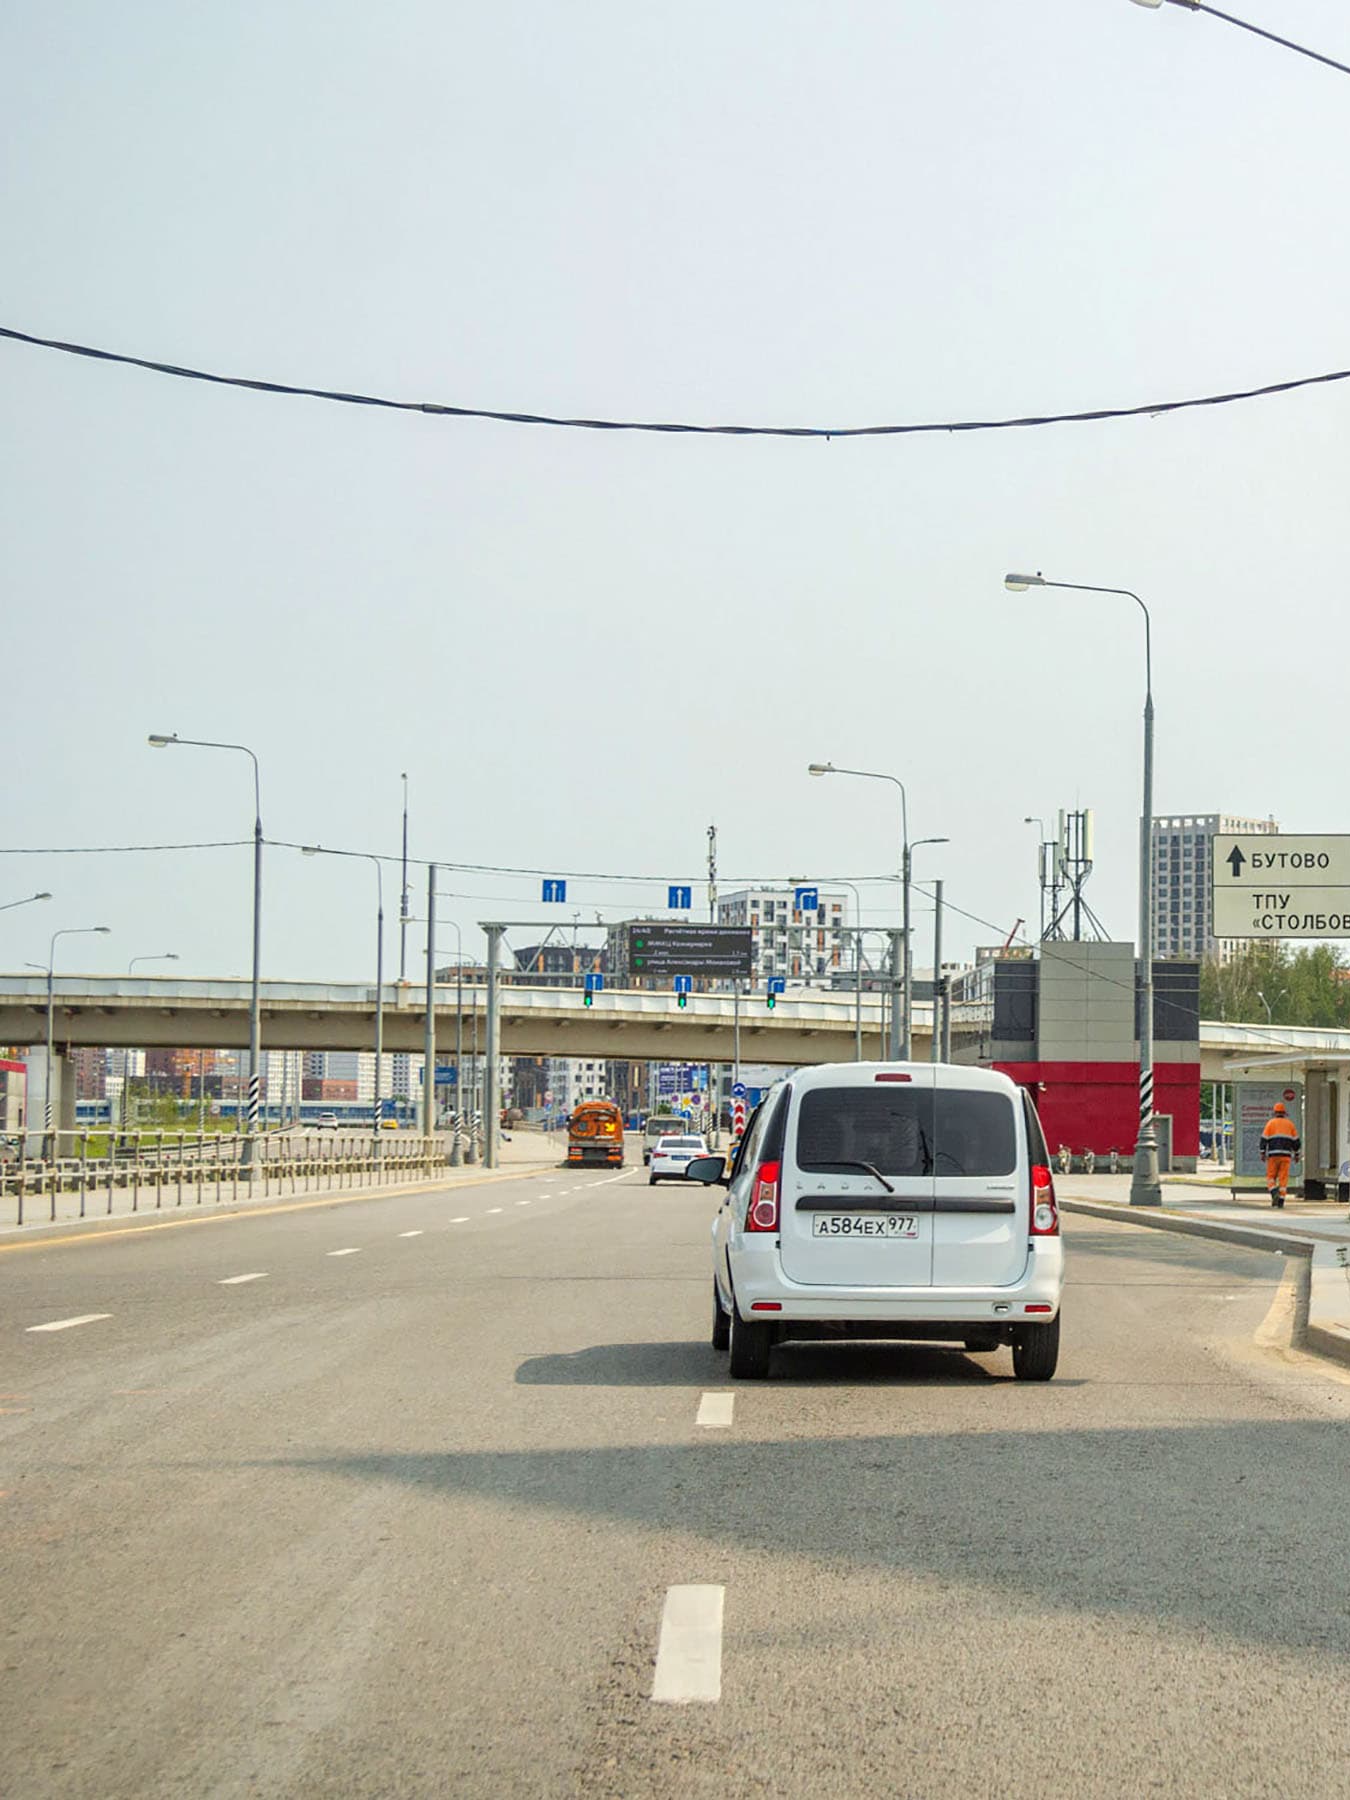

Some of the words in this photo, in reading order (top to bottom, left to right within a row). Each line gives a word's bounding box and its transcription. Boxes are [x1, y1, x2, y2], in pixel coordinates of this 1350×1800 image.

[1252, 852, 1330, 869] БУТОВО
[1252, 893, 1291, 910] ТПУ
[819, 1217, 885, 1234] А584ЕХ
[888, 1217, 914, 1231] 977
